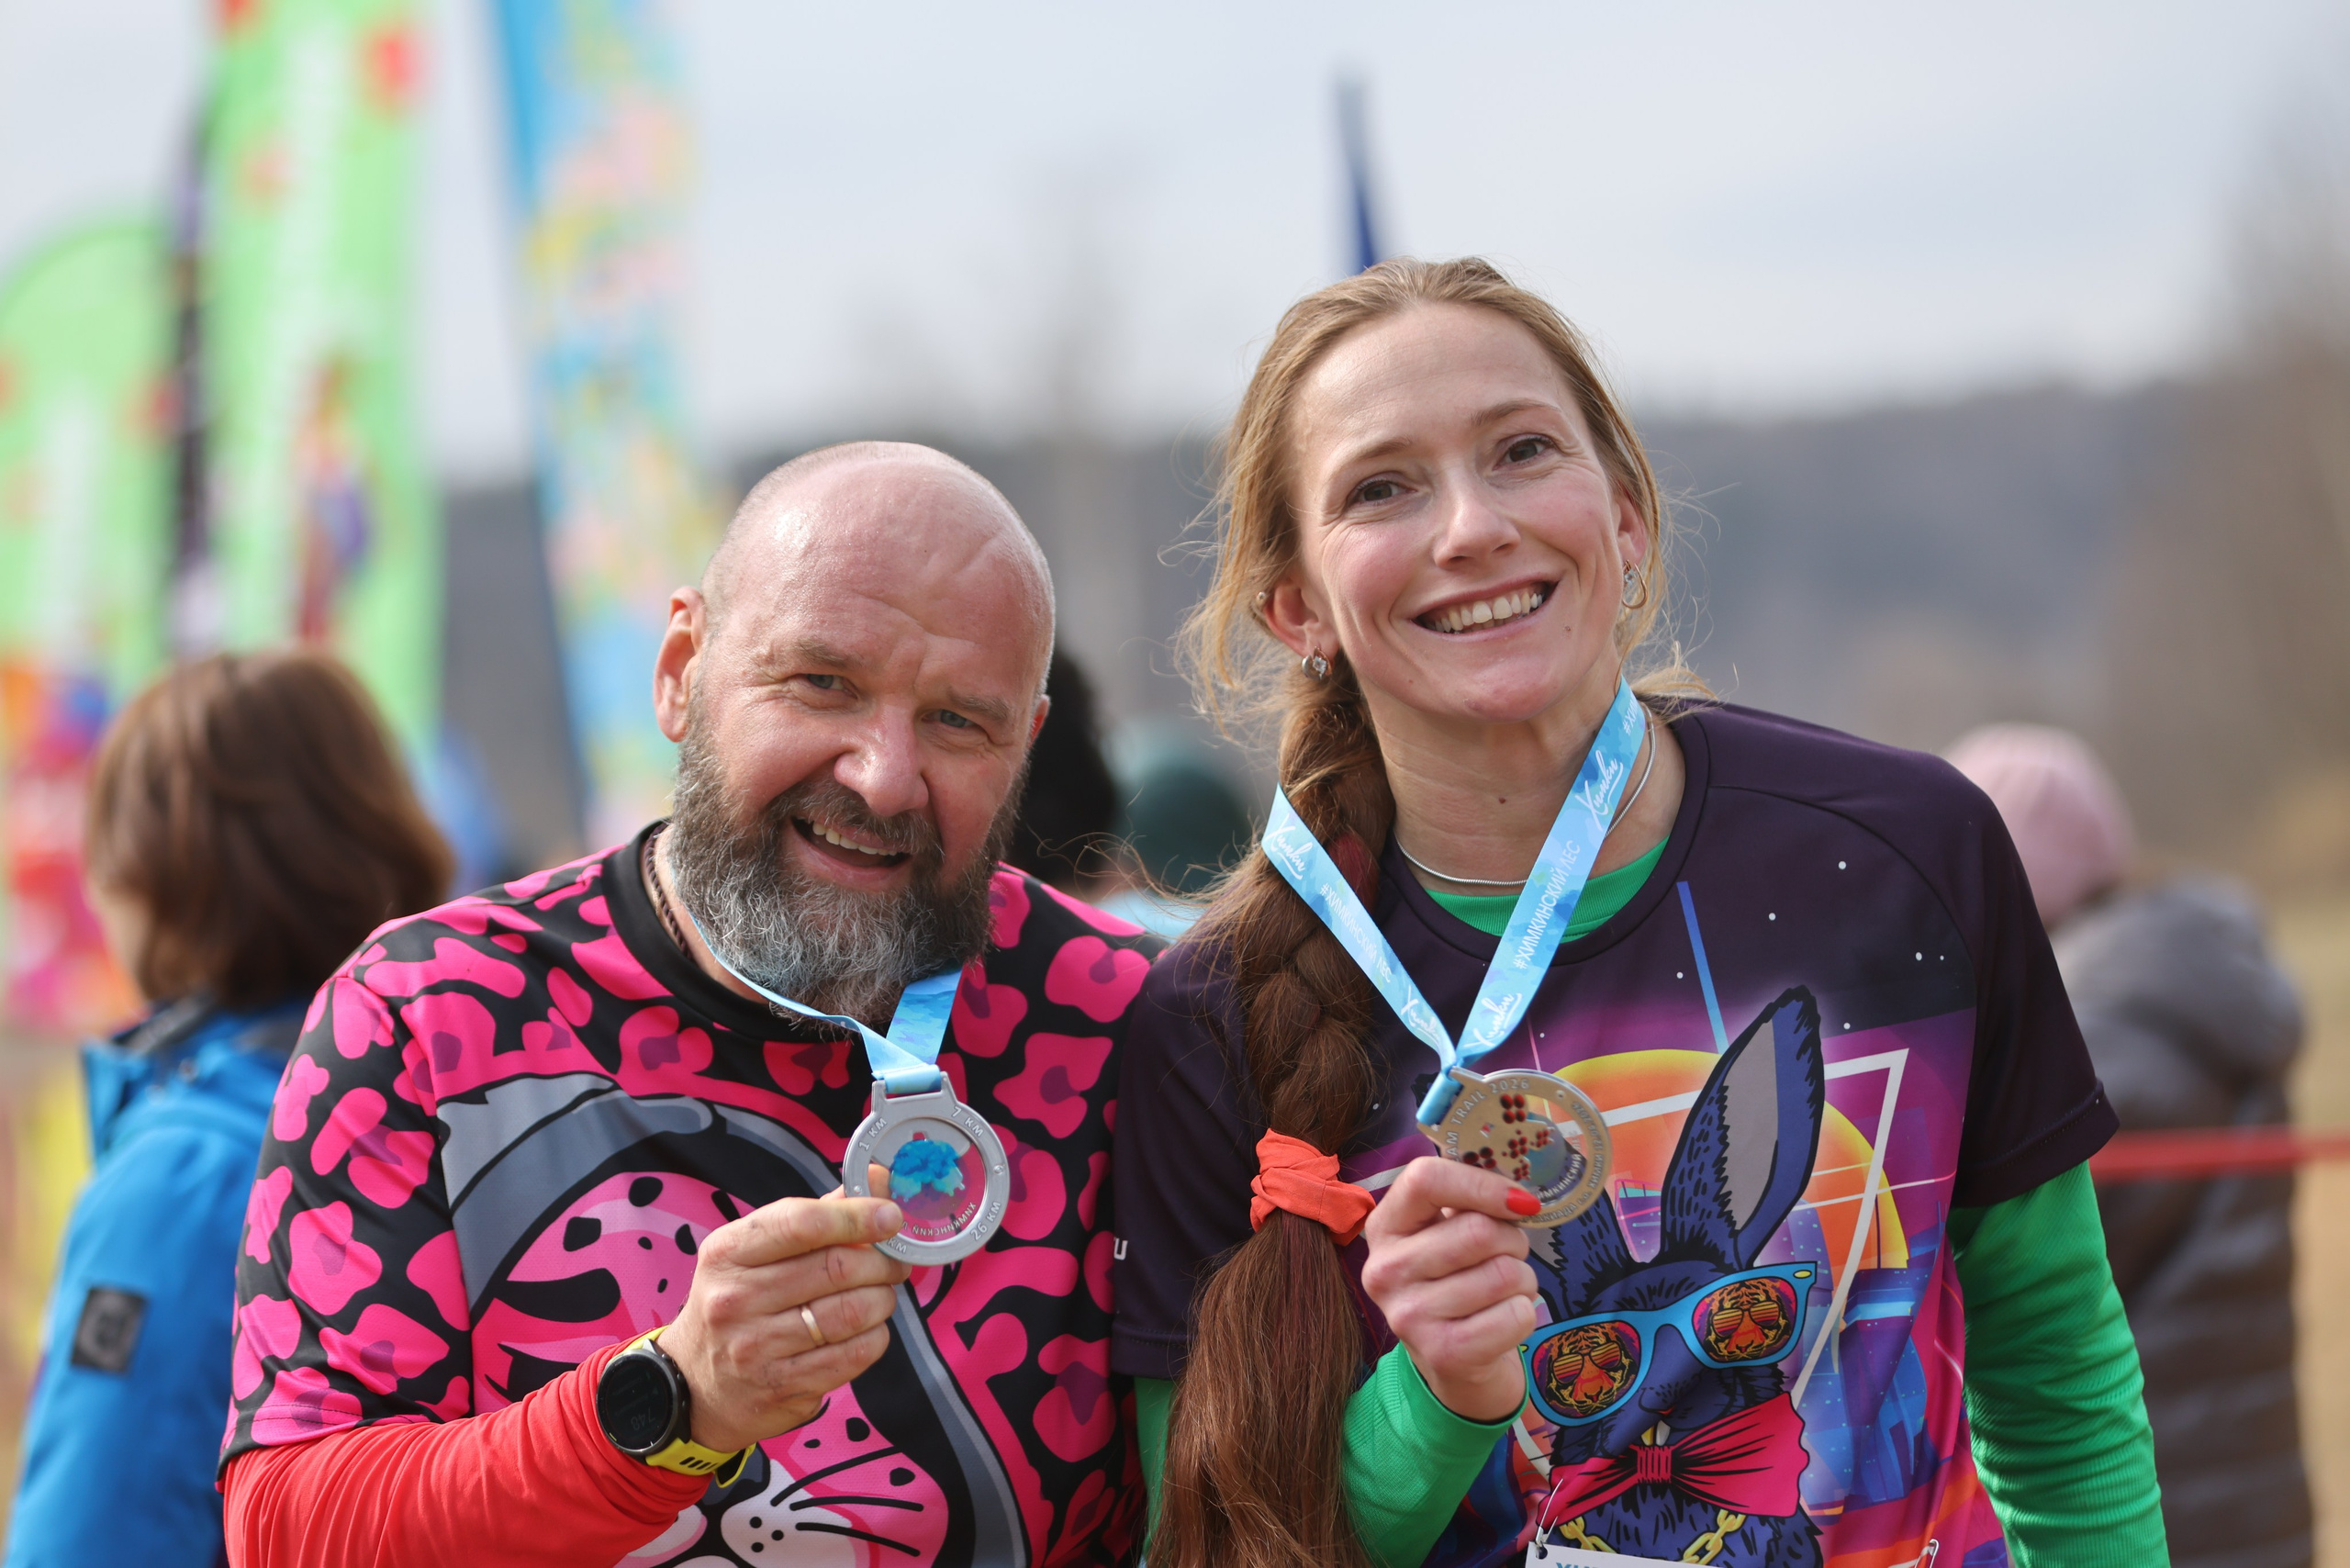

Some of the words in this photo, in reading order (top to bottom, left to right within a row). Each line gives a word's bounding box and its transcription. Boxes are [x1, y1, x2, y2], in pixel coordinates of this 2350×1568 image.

[1513, 867, 1570, 969] #ХИМКИНСКИЙ
[1560, 840, 1581, 870] ЛЕС
[1320, 882, 1378, 964] #ХИМКИНСКИЙ
[1377, 957, 1392, 982] ЛЕС
[950, 1105, 962, 1118] 7
[1450, 1090, 1487, 1126] TRAIL
[1490, 1078, 1529, 1094] 2026
[858, 1140, 870, 1151] 1
[1537, 1152, 1582, 1200] ИМКИНСКИЙ
[1588, 1153, 1604, 1189] ХИМКИ
[970, 1221, 989, 1241] 26
